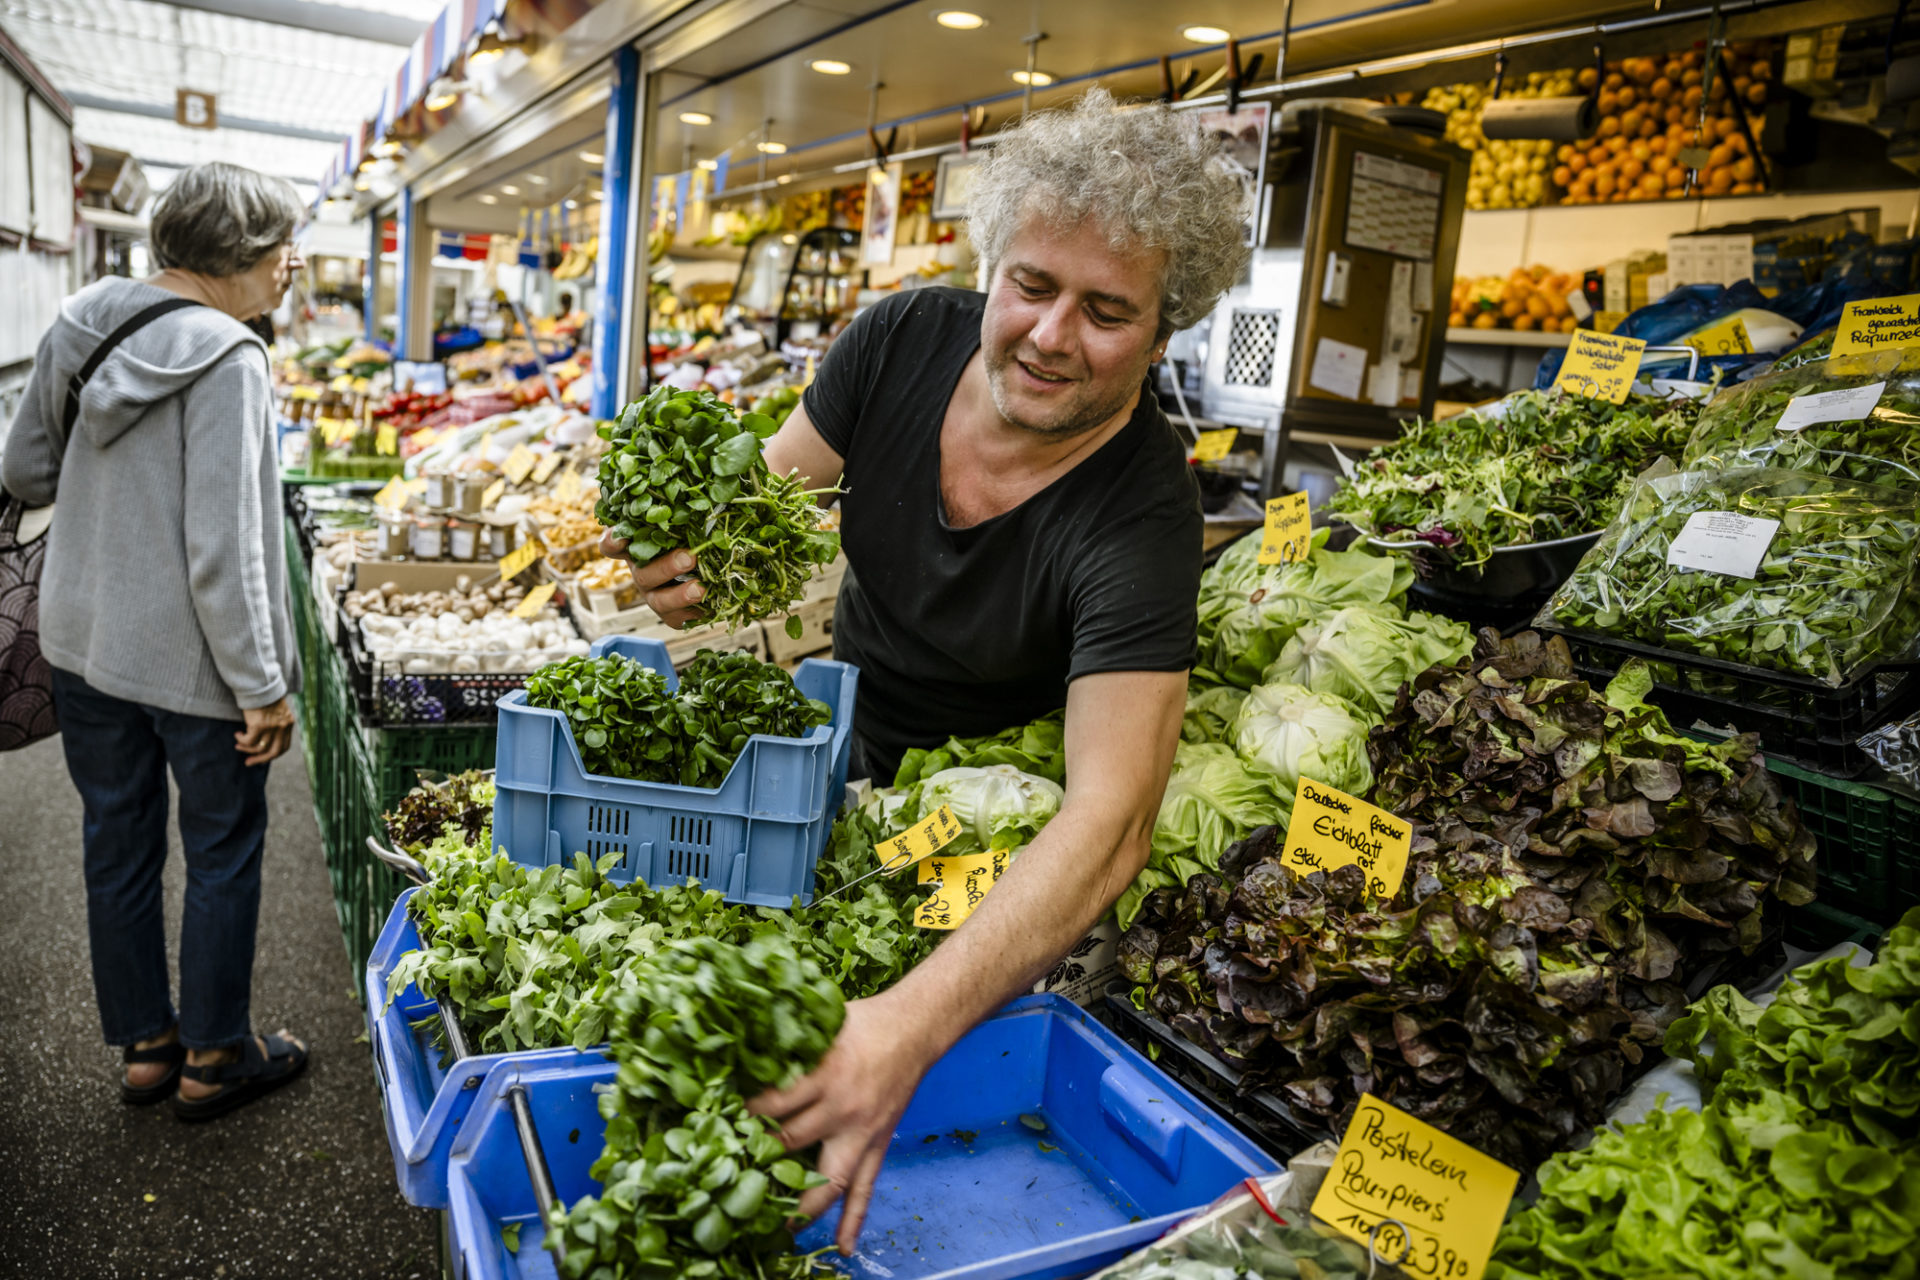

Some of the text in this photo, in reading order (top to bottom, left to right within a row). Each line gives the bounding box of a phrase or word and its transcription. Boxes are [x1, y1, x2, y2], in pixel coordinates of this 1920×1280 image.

[185, 94, 208, 124] B
[1852, 304, 1905, 317] Frankreich
[1313, 815, 1383, 859] Eichblatt
[1357, 855, 1375, 871] rot
